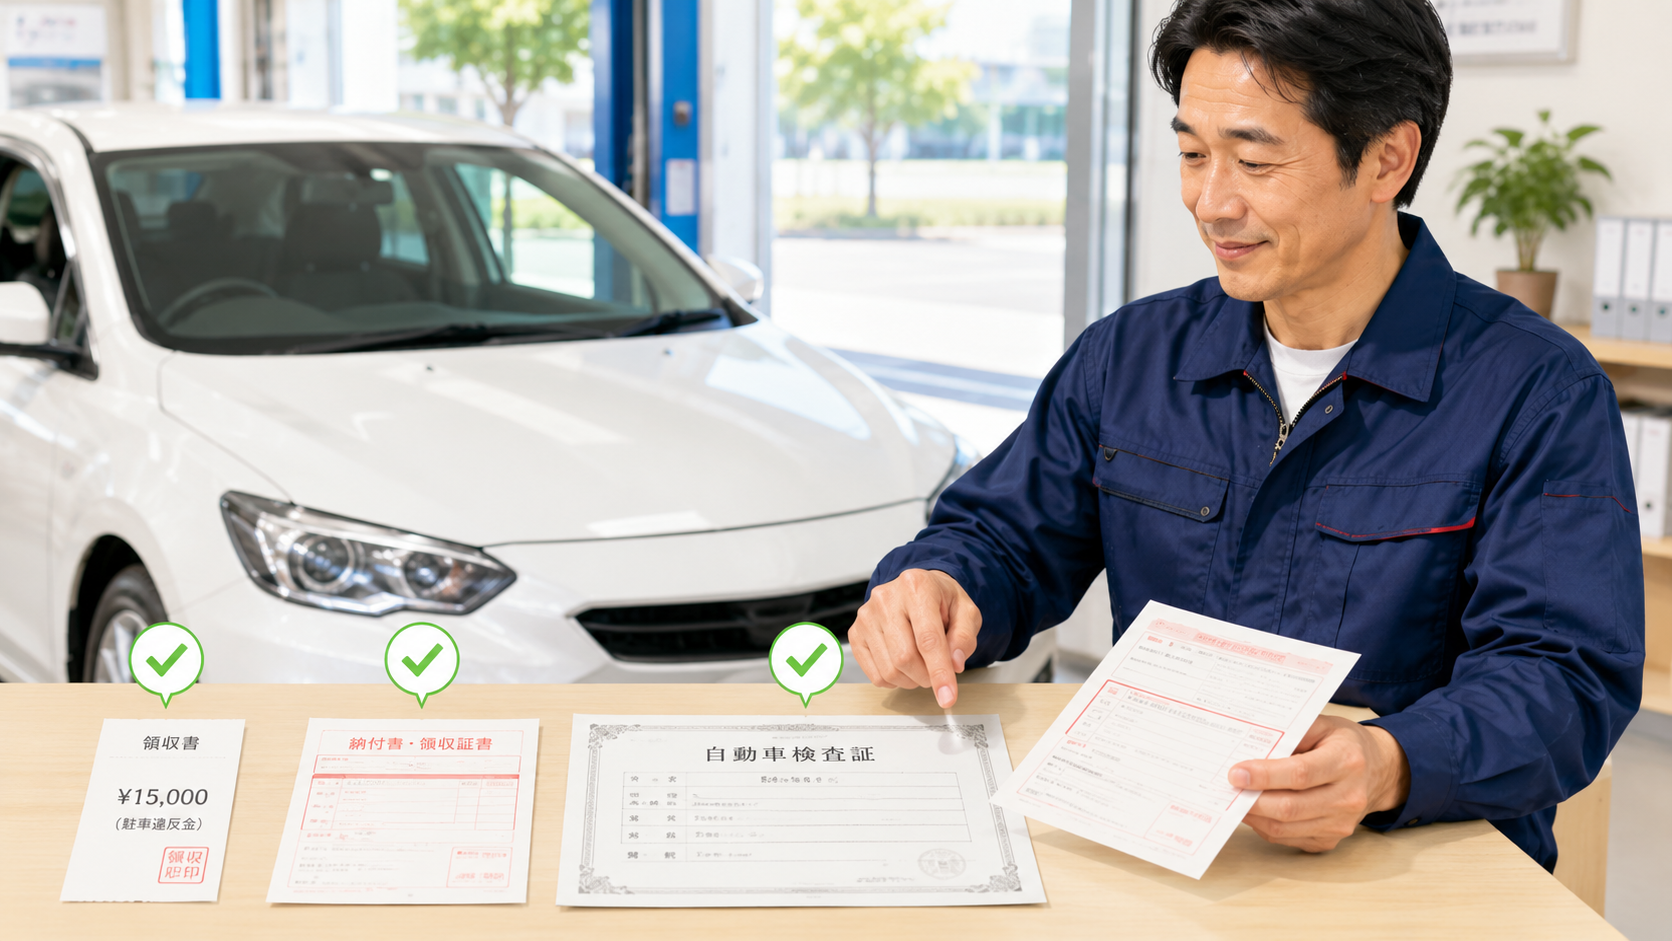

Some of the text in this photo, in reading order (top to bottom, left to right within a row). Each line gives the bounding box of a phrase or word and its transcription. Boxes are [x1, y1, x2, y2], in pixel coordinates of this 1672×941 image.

[143, 735, 200, 751] 領収書
[706, 745, 876, 763] 自動車検査証
[117, 788, 209, 808] ¥15,000
